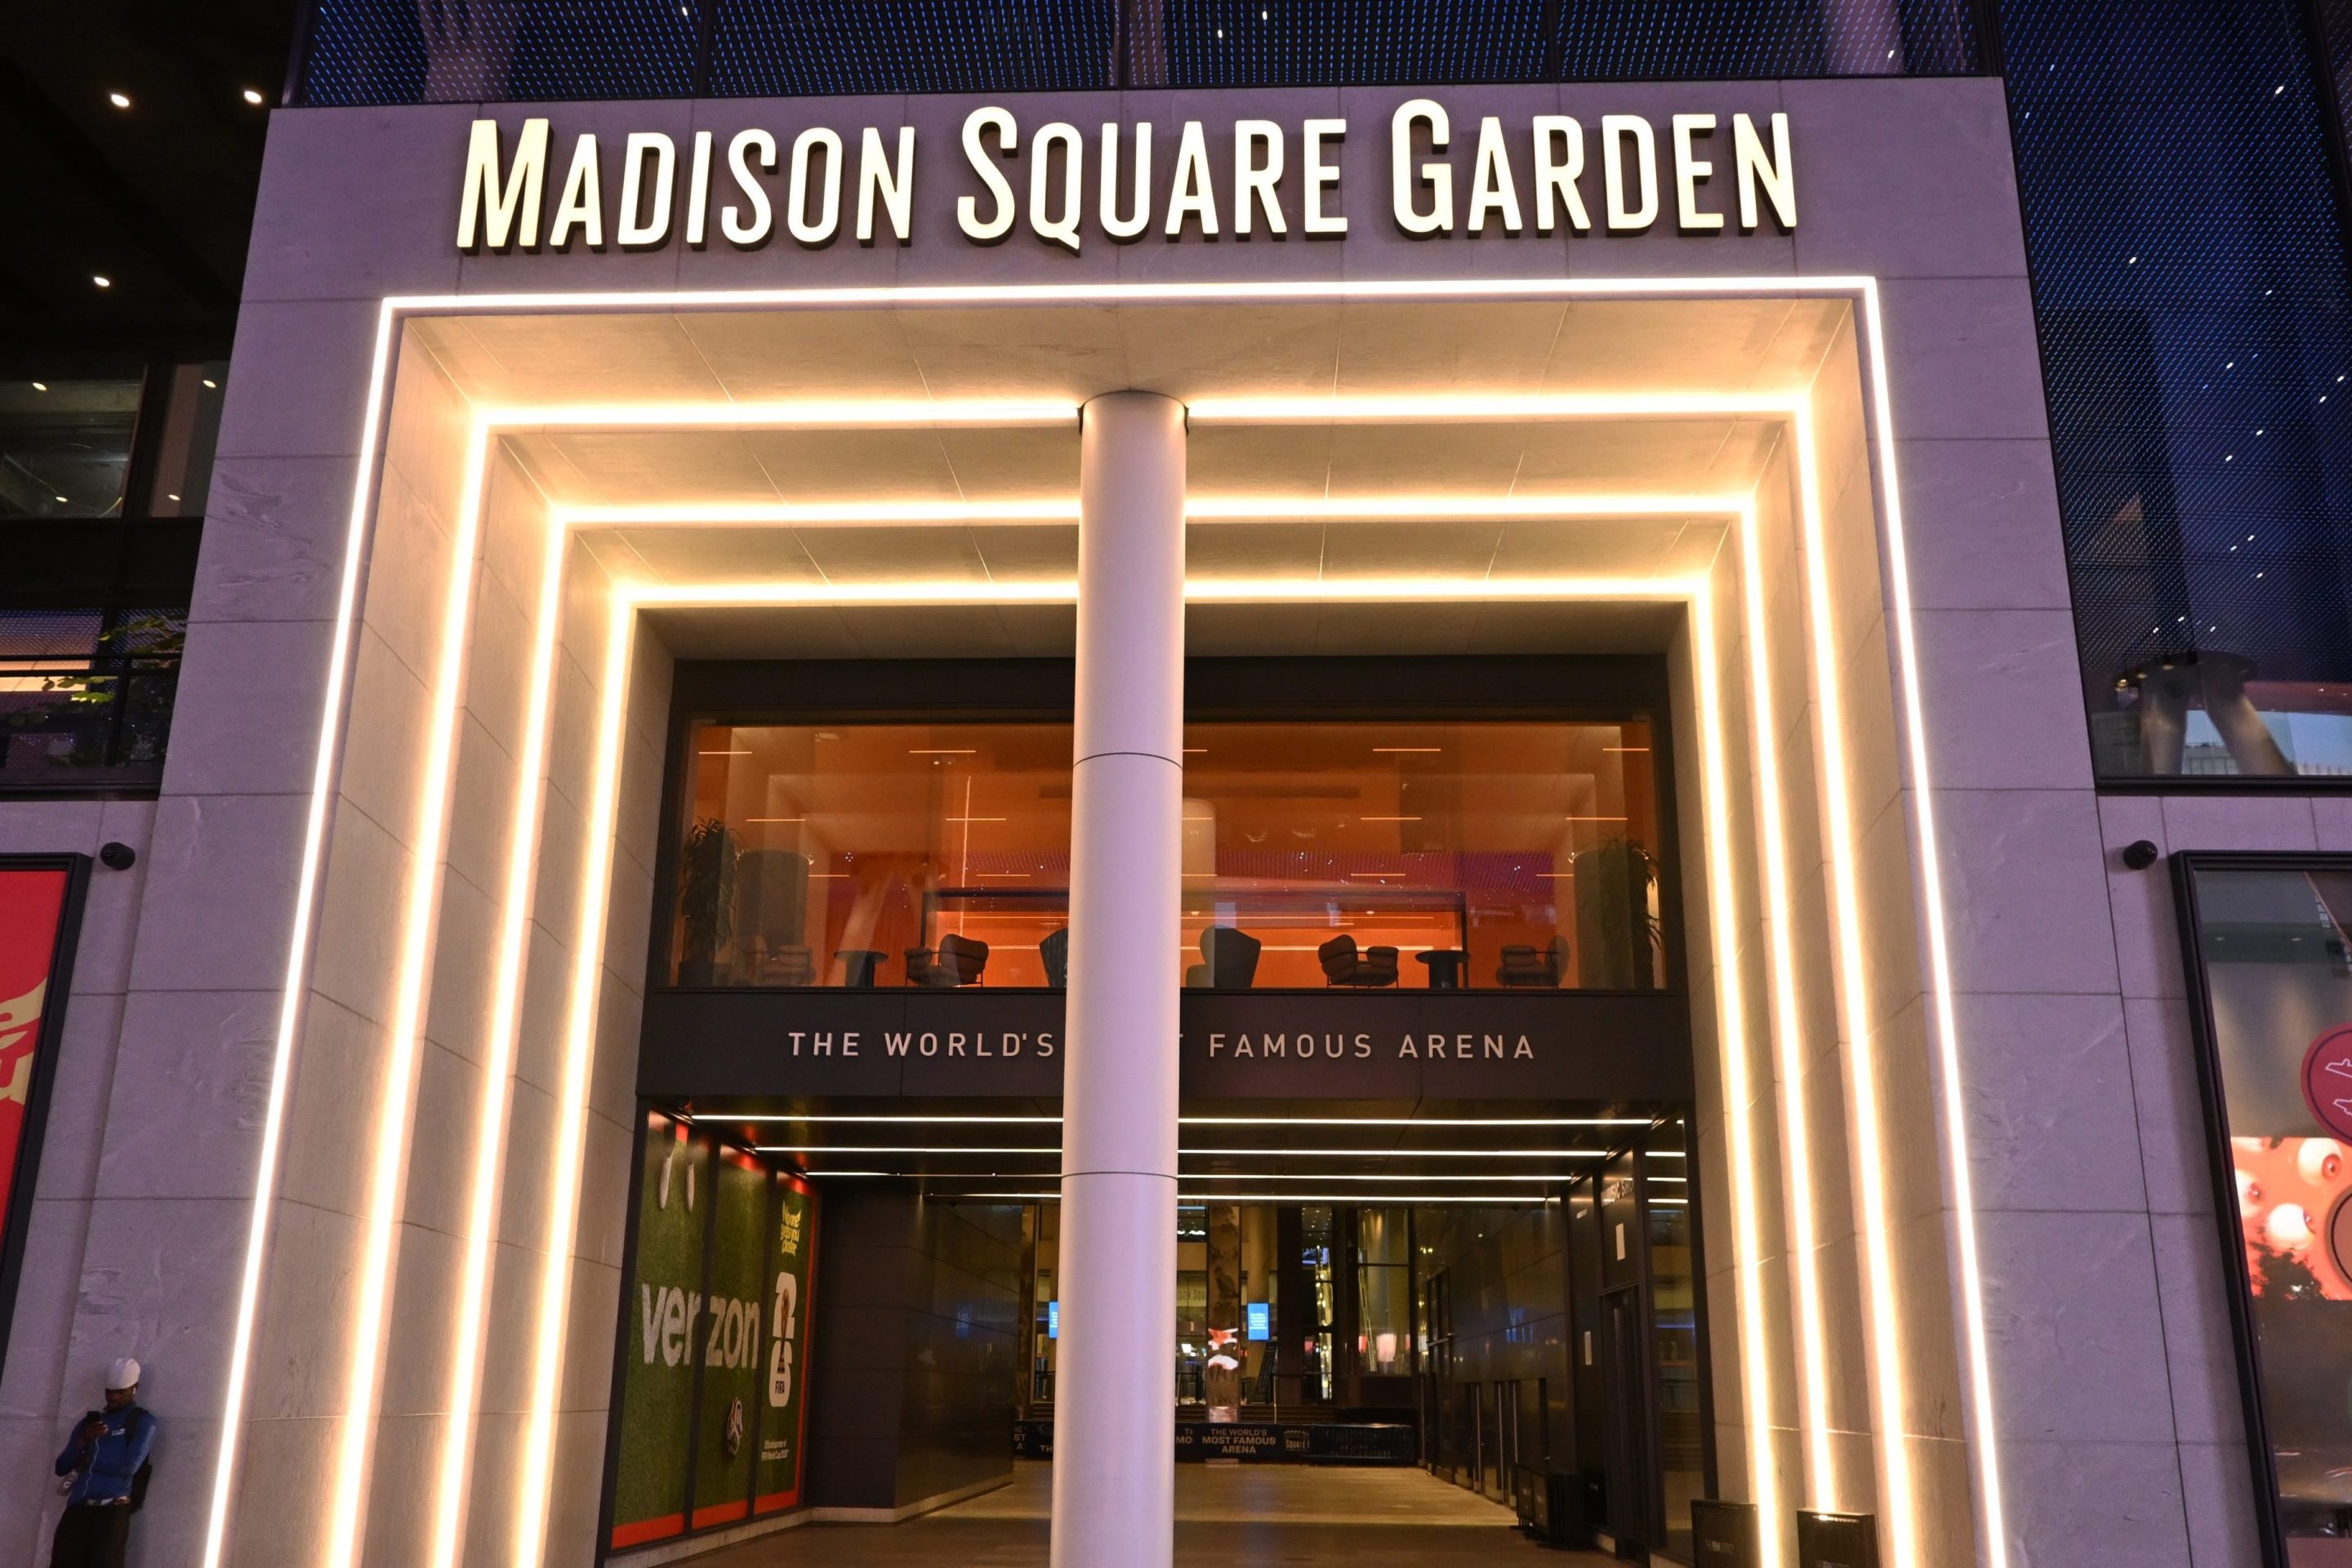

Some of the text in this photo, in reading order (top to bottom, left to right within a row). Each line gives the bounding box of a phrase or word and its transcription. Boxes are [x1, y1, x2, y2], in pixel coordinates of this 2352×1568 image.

[457, 98, 1797, 253] MADISON SQUARE GARDEN
[788, 1031, 1535, 1060] THE WORLD'S FAMOUS ARENA
[642, 1283, 760, 1369] verzon
[1202, 1437, 1276, 1445] MOST FAMOUS
[1222, 1446, 1257, 1454] ARENA
